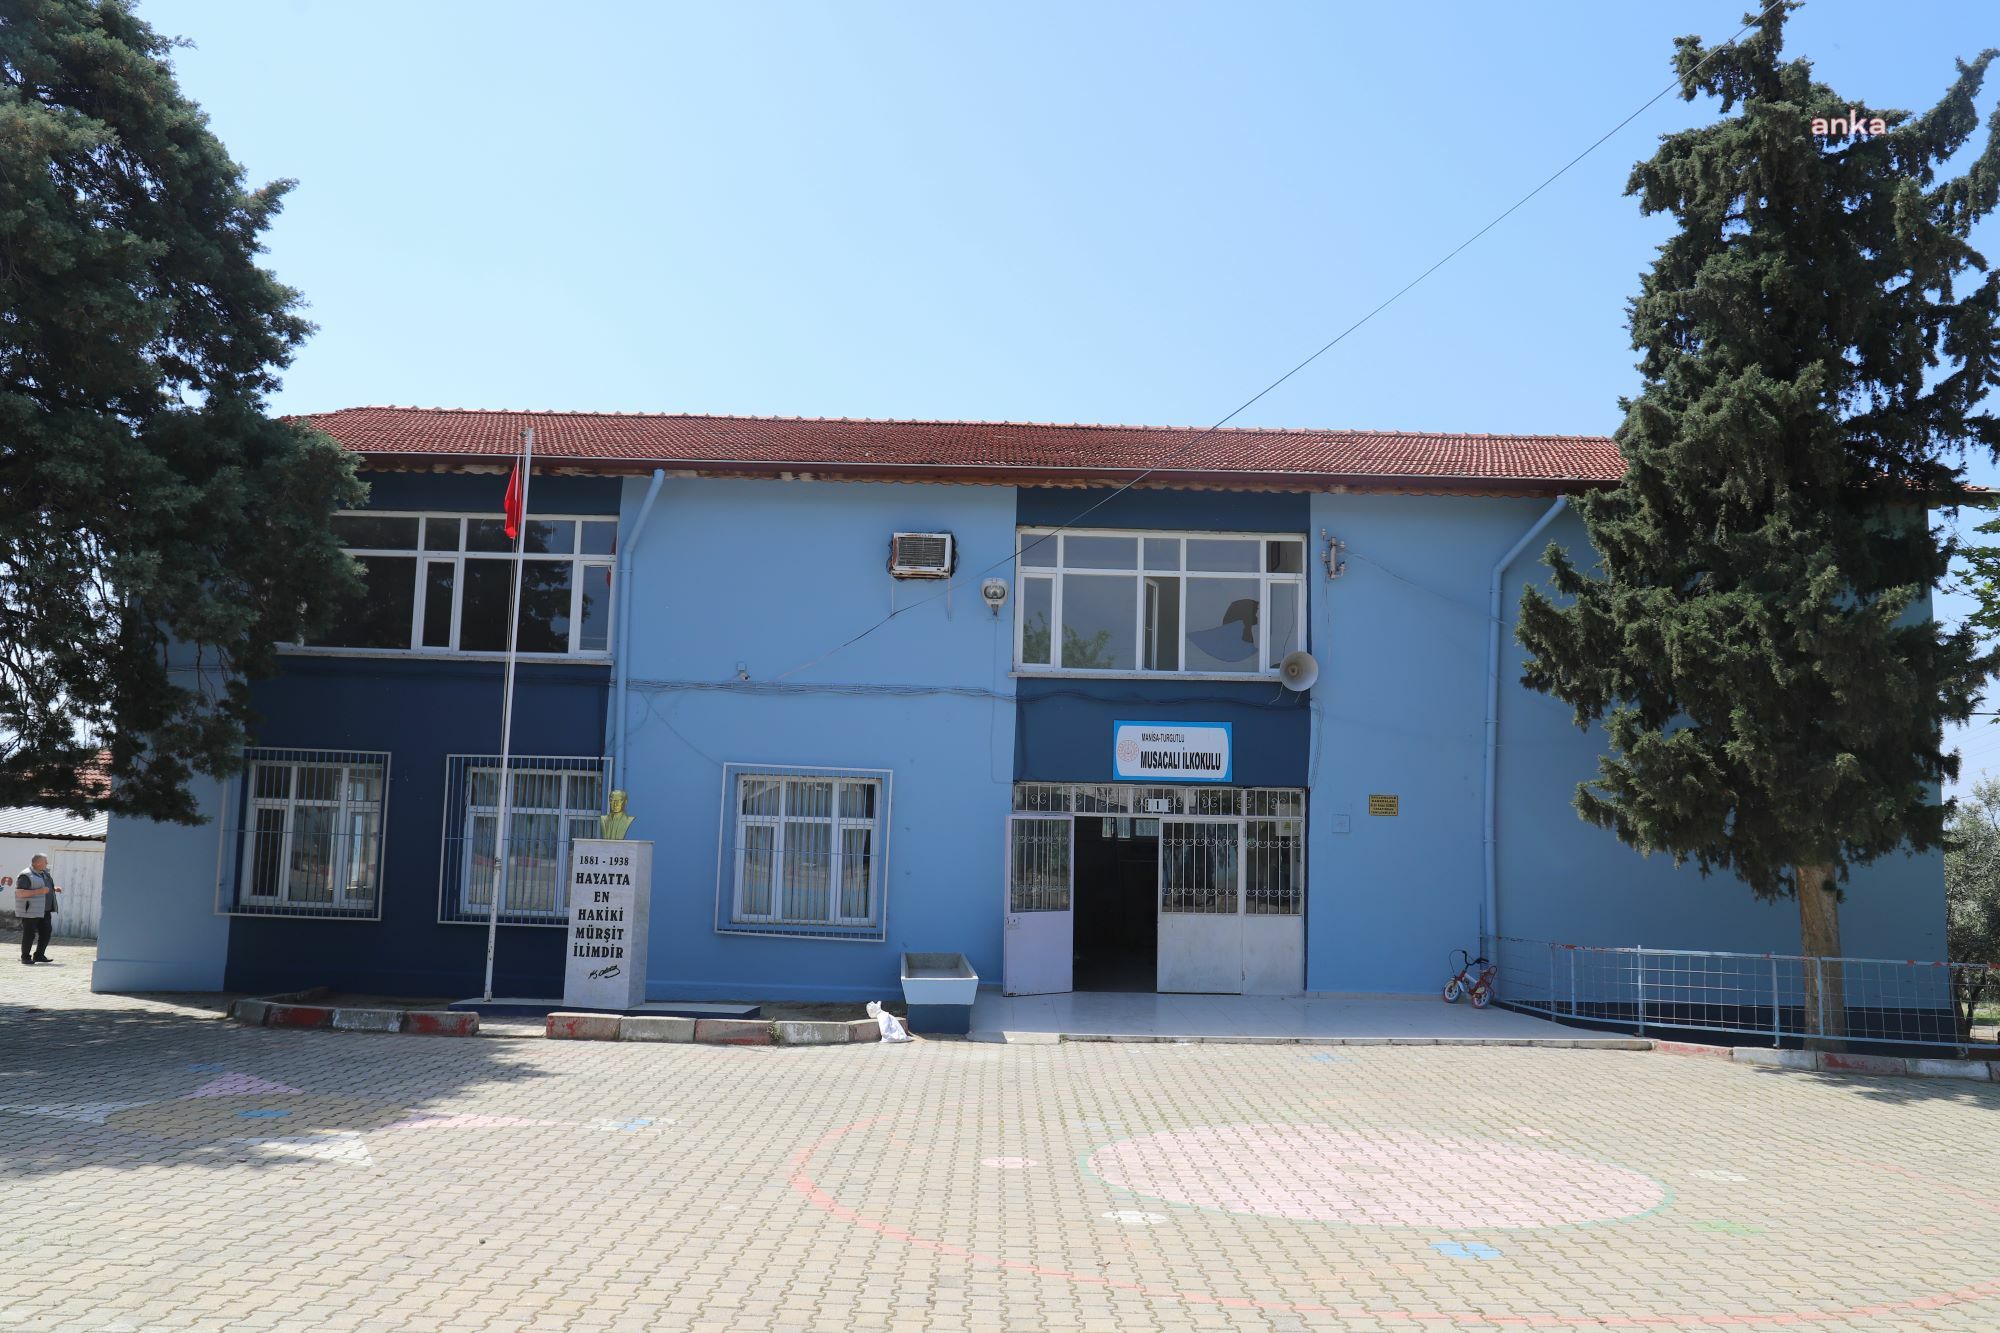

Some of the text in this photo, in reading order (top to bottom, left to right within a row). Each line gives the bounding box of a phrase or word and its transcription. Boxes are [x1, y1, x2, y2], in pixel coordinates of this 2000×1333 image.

[1141, 731, 1185, 743] MANİSA-TURGUTLU
[1140, 747, 1221, 771] MUSACALI İLKOKULU
[579, 855, 599, 865] 1881
[609, 856, 629, 866] 1938
[575, 872, 630, 886] HAYATTA
[593, 891, 610, 903] EN
[577, 906, 624, 922] HAKİKİ
[575, 924, 624, 943] MÜRŞİT
[572, 942, 624, 959] İLİMDİR
